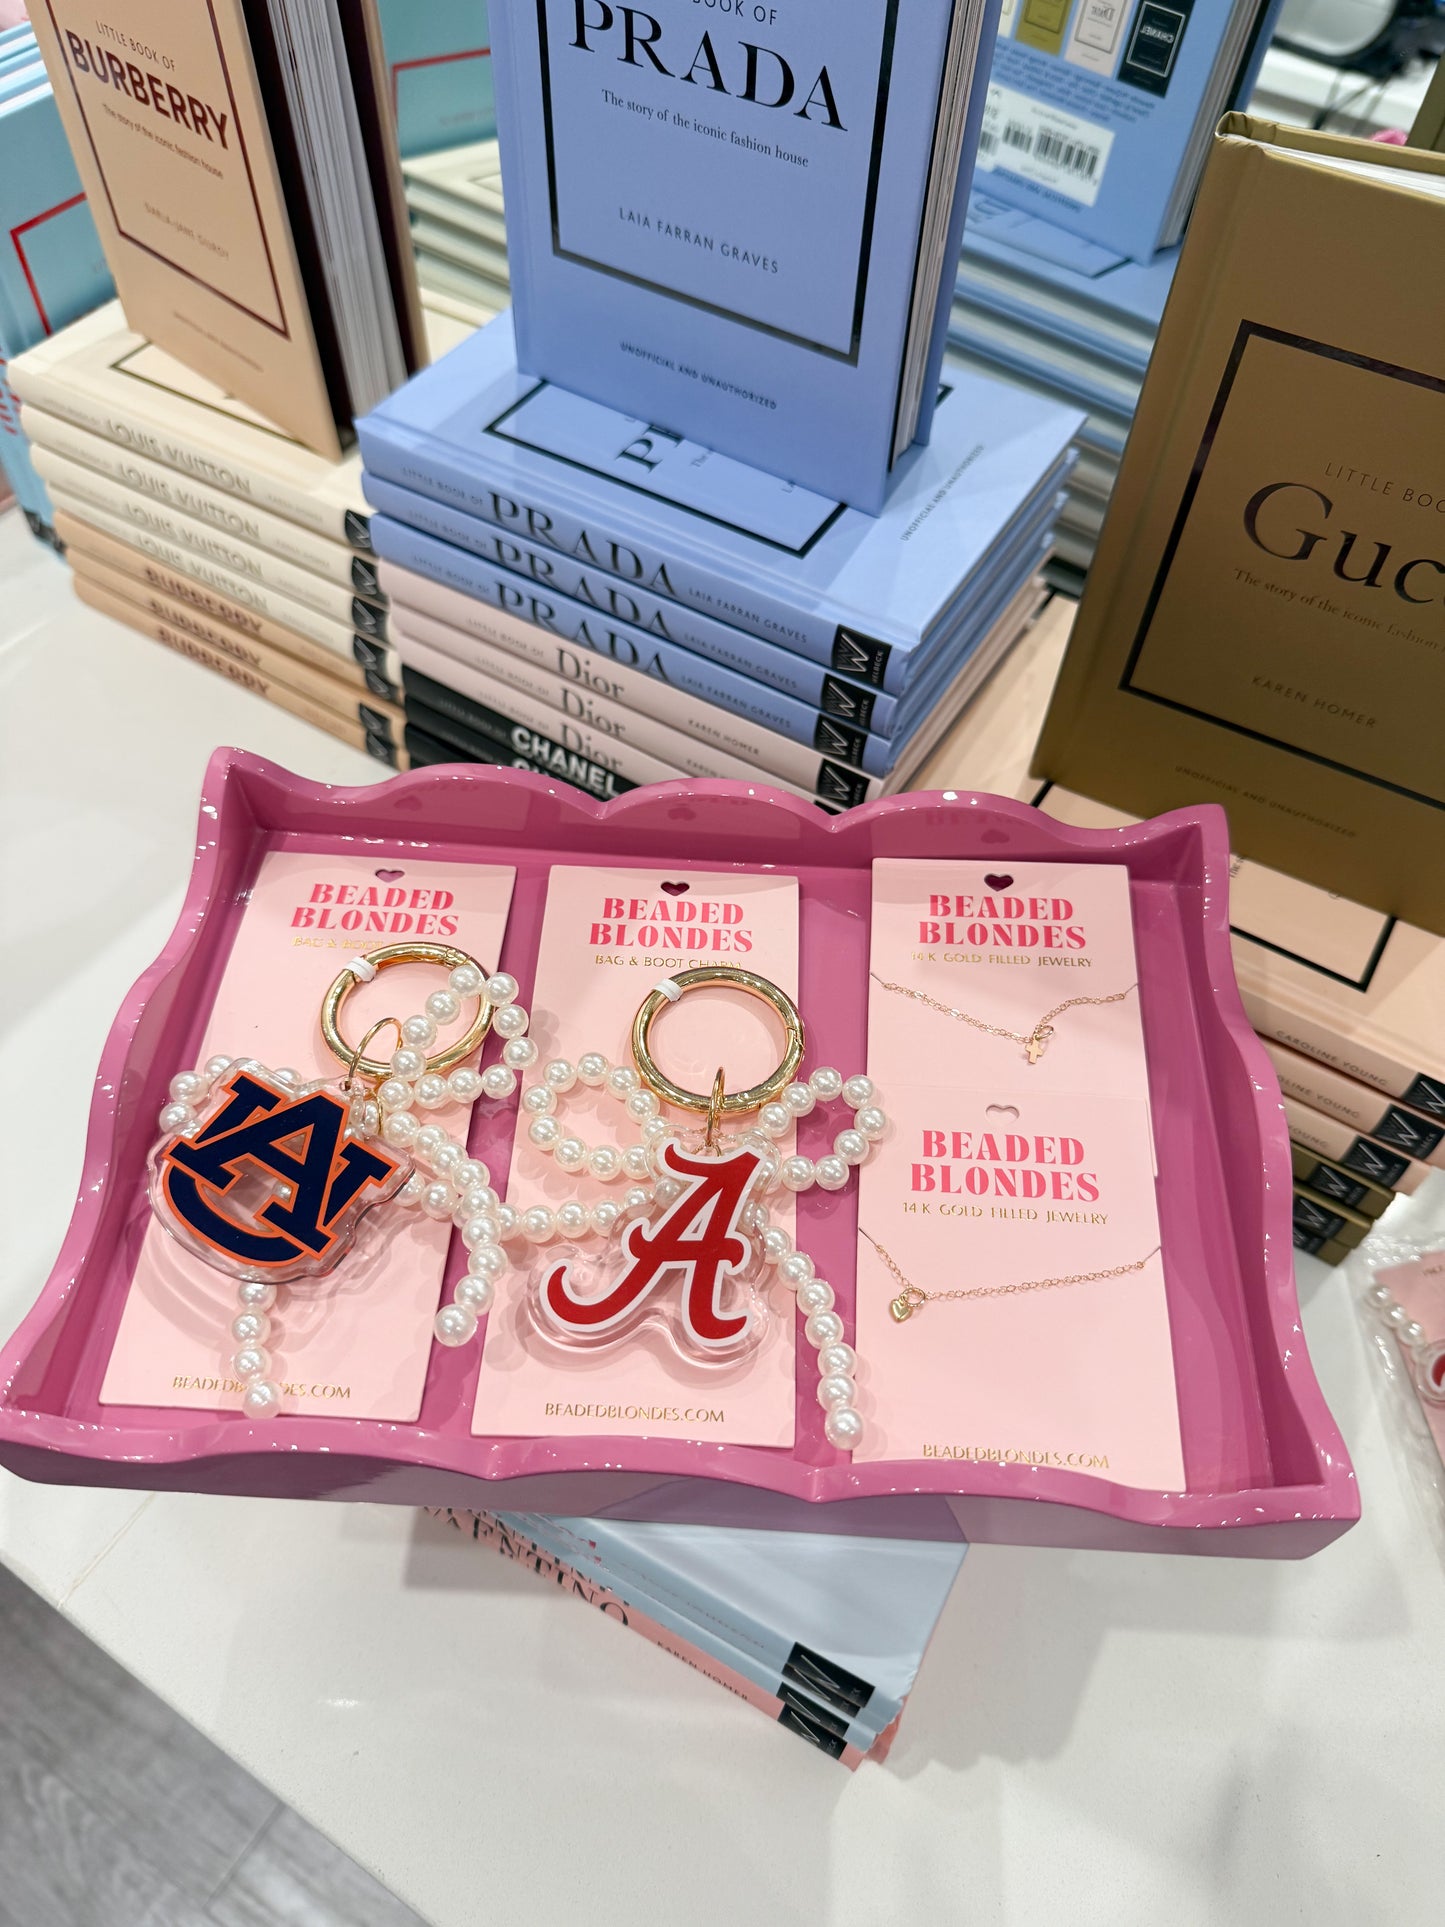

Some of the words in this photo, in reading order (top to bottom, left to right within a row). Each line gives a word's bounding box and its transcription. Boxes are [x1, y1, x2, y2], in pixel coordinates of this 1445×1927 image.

[693, 0, 744, 16] OOK
[754, 6, 777, 25] OF
[95, 20, 127, 46] LITTLE
[130, 38, 159, 62] BOOK
[162, 55, 176, 71] OF
[569, 0, 848, 131] PRADA
[65, 28, 229, 150] BURBERRY
[602, 88, 624, 108] The
[627, 98, 654, 120] story
[657, 109, 670, 122] of
[673, 113, 690, 129] the
[694, 118, 727, 141] iconic
[730, 131, 771, 156] fashion
[775, 145, 809, 168] house
[619, 207, 650, 228] LAIA
[657, 221, 714, 251] FARRAN
[721, 243, 778, 274] GRAVES
[620, 341, 675, 371] UNOFFICIAL
[679, 363, 698, 379] AND
[702, 373, 777, 410] UNAUTHORIZED
[107, 419, 161, 456] LOUIS
[166, 446, 252, 495] VUITTON
[1325, 462, 1394, 496] LITTLE
[119, 463, 173, 499] LOUIS
[175, 488, 260, 539] VUITTON
[900, 502, 936, 542] UNOFFICIAL
[1243, 482, 1445, 604] Guc
[488, 491, 678, 597] PRADA
[689, 587, 712, 603] LAIA
[717, 599, 760, 624] FARRAN
[764, 618, 807, 644] GRAVES
[491, 536, 673, 639] PRADA
[711, 646, 752, 669] FARRAN
[756, 665, 797, 689] GRAVES
[1234, 568, 1259, 586] The
[1264, 582, 1297, 602] story
[1301, 595, 1317, 607] of
[1318, 599, 1340, 615] the
[495, 580, 672, 683] PRADA
[750, 706, 791, 729] GRAVES
[557, 648, 625, 700] Dior
[688, 719, 721, 739] KAREN
[723, 733, 760, 755] HOMER
[561, 687, 626, 739] Dior
[1252, 676, 1307, 702] KAREN
[1313, 700, 1376, 728] HOMER
[511, 726, 621, 798] CHANEL
[560, 721, 624, 772] Dior
[309, 883, 454, 910] BEADED
[603, 897, 744, 924] BEADED
[929, 895, 1073, 921] BEADED
[290, 907, 459, 936] BLONDES
[293, 935, 323, 948] BAG
[327, 938, 337, 948] &
[589, 923, 753, 953] BLONDES
[919, 921, 1086, 950] BLONDES
[595, 955, 624, 966] BAG
[629, 956, 638, 966] &
[644, 957, 684, 968] BOOT
[912, 952, 924, 961] 14
[928, 953, 936, 962] K
[943, 953, 982, 964] GOLD
[989, 954, 1031, 965] FILLED
[1038, 957, 1093, 968] JEWELRY
[1275, 1030, 1338, 1063] CAROLINE
[1343, 1061, 1389, 1087] YOUNG
[1316, 1094, 1360, 1119] YOUNG
[922, 1130, 1085, 1166] BEADED
[911, 1163, 1100, 1203] BLONDES
[903, 1202, 917, 1213] 14
[922, 1203, 932, 1214] K
[939, 1204, 983, 1217] GOLD
[991, 1207, 1038, 1220] FILLED
[1046, 1211, 1109, 1225] JEWELRY
[173, 1376, 351, 1398] BEADEDBDES.COM
[545, 1402, 725, 1422] BEADEDBLONDES.COM
[923, 1444, 1109, 1469] BEADEDBLONDES.COM
